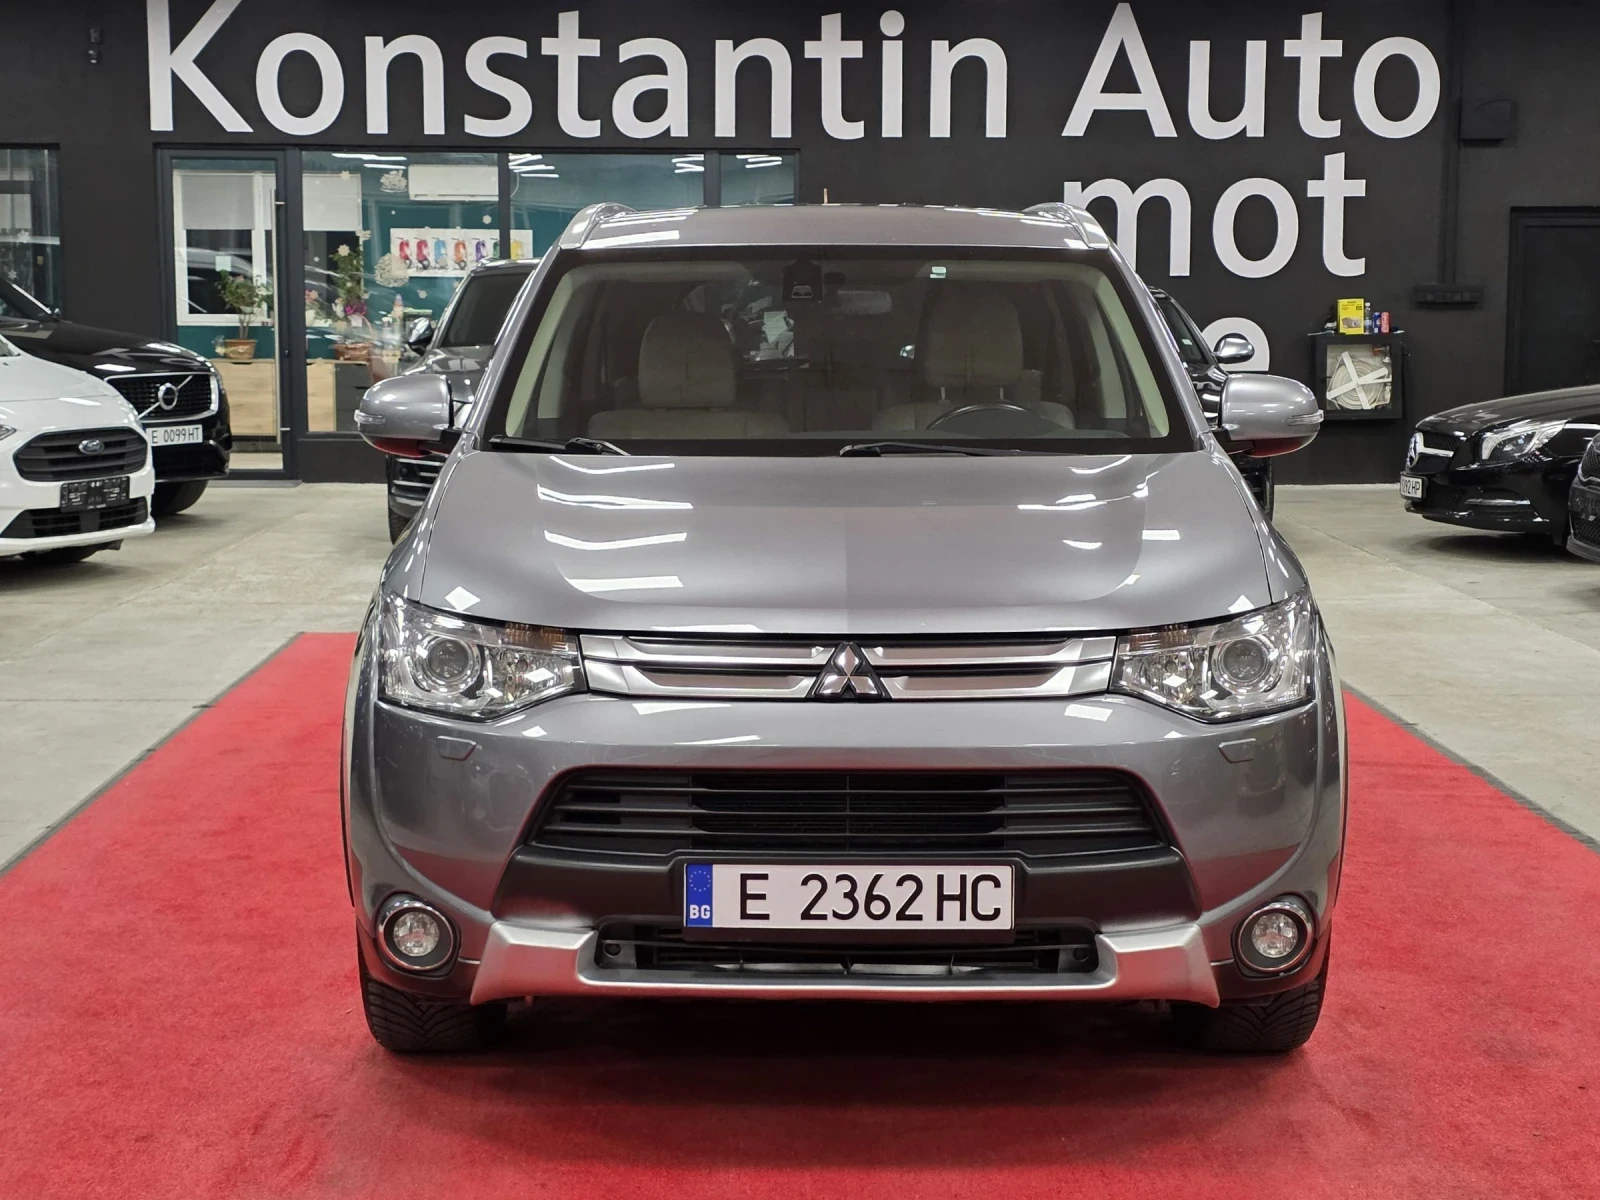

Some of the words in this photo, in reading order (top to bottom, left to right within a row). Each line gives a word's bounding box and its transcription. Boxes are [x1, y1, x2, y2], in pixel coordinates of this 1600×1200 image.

[147, 0, 1008, 140] Konstantin
[1061, 2, 1441, 140] Auto
[1063, 151, 1367, 279] mot
[152, 430, 159, 444] E
[689, 904, 711, 920] BG
[739, 873, 770, 920] E
